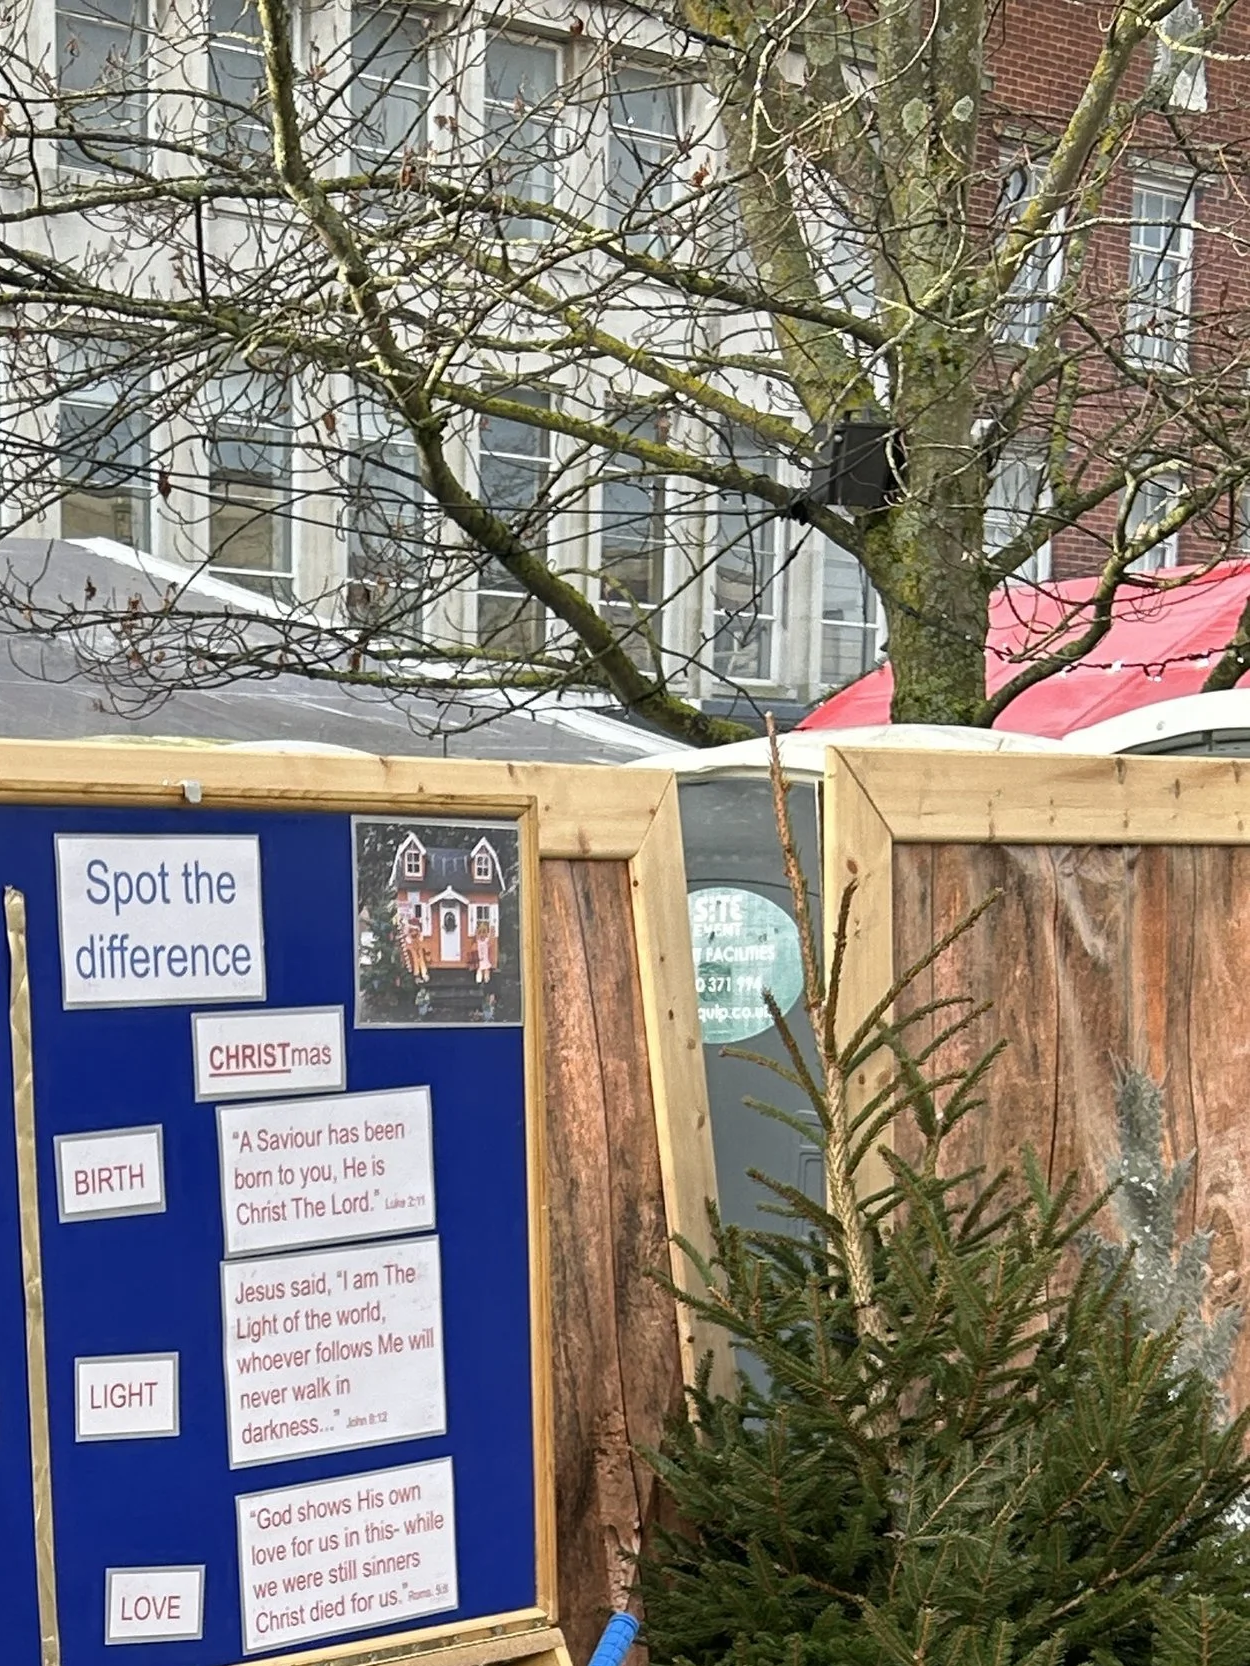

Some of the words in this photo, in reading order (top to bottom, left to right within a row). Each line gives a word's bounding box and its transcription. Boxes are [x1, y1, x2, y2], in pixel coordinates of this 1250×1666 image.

[86, 858, 169, 915] Spot
[182, 861, 236, 904] the
[693, 895, 743, 922] SITE
[76, 934, 251, 979] difference
[706, 945, 775, 962] FACILITIES
[708, 976, 731, 992] 371
[209, 1042, 331, 1073] CHRISTmas
[257, 1127, 322, 1151] Saviour
[328, 1124, 359, 1145] has
[364, 1121, 405, 1142] been
[74, 1163, 145, 1196] BIRTH
[234, 1168, 272, 1190] born
[278, 1166, 294, 1185] to
[300, 1165, 337, 1189] you,
[343, 1157, 367, 1179] He
[372, 1155, 385, 1176] is
[236, 1201, 287, 1225] Christ
[291, 1197, 325, 1219] The
[235, 1282, 285, 1304] Jesus
[290, 1272, 331, 1298] said,
[353, 1272, 378, 1289] am
[383, 1263, 416, 1286] The
[236, 1315, 278, 1343] Light
[283, 1311, 299, 1334] of
[305, 1309, 331, 1331] the
[337, 1300, 386, 1326] world,
[237, 1349, 311, 1375] whoever
[316, 1340, 372, 1364] follows
[378, 1333, 404, 1355] Me
[408, 1327, 434, 1350] will
[90, 1382, 158, 1410] LIGHT
[240, 1386, 287, 1410] never
[292, 1377, 330, 1403] walk
[336, 1374, 351, 1395] in
[346, 1416, 367, 1429] John
[297, 1497, 351, 1522] shows
[357, 1488, 384, 1511] His
[389, 1484, 421, 1505] own
[251, 1544, 286, 1566] love
[291, 1535, 313, 1557] for
[319, 1534, 339, 1553] us
[344, 1526, 360, 1548] in
[404, 1510, 444, 1536] while
[253, 1580, 278, 1600] we
[282, 1570, 323, 1594] were
[328, 1559, 357, 1584] still
[362, 1551, 421, 1578] sinners
[120, 1595, 181, 1621] LOVE
[255, 1608, 306, 1634] Christ
[310, 1595, 345, 1623] died
[350, 1592, 374, 1613] for
